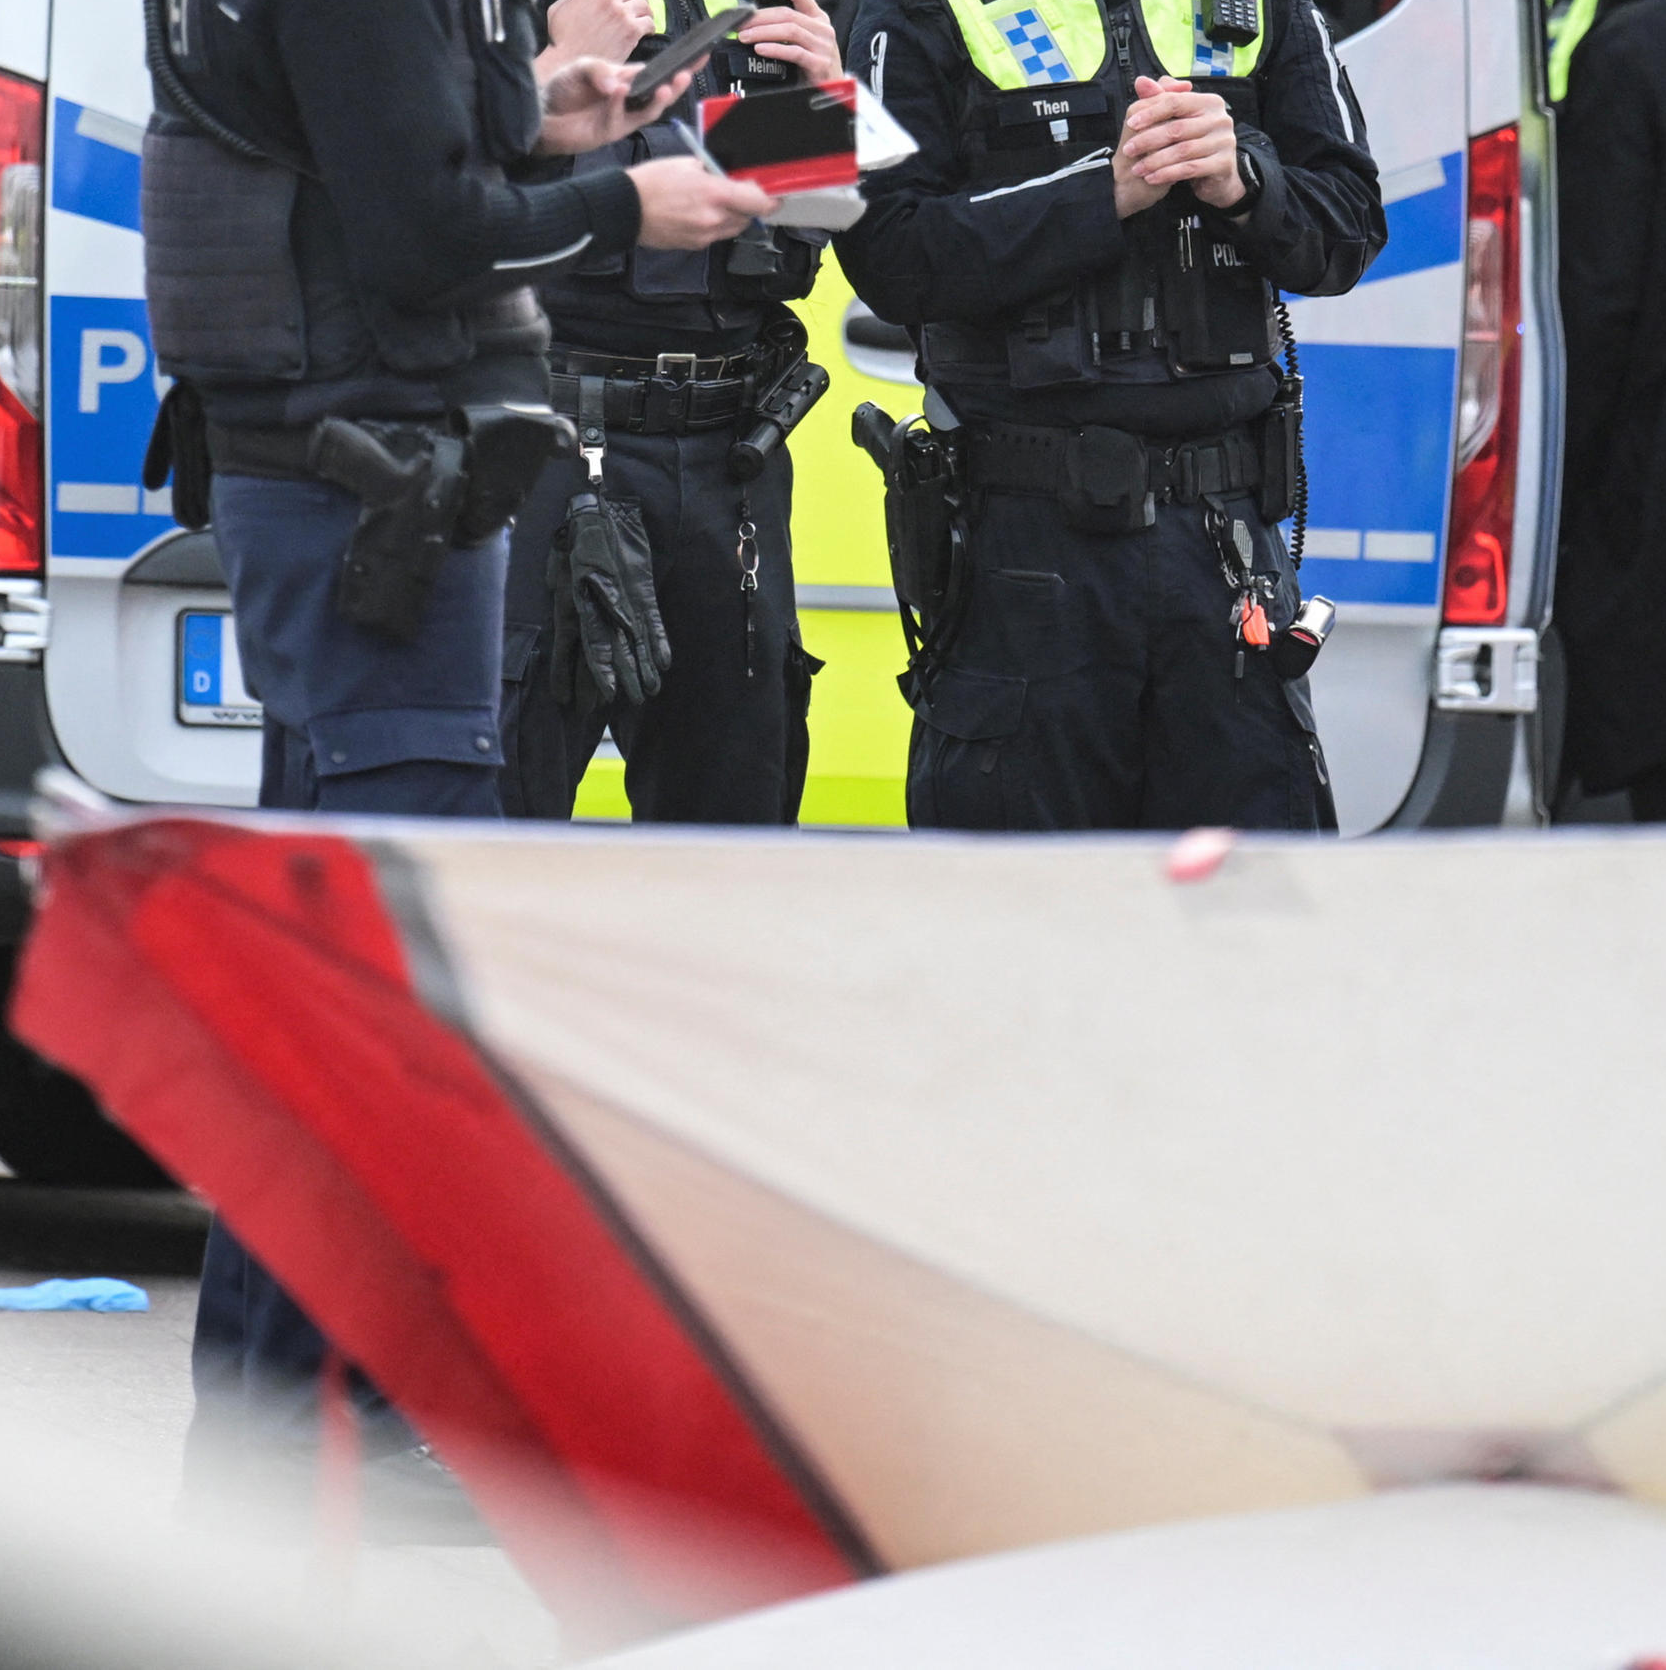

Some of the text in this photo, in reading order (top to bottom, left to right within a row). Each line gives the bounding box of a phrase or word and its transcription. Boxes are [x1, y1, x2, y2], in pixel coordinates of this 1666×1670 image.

[1033, 99, 1070, 117] Then
[1213, 243, 1243, 266] POL
[193, 670, 211, 693] D
